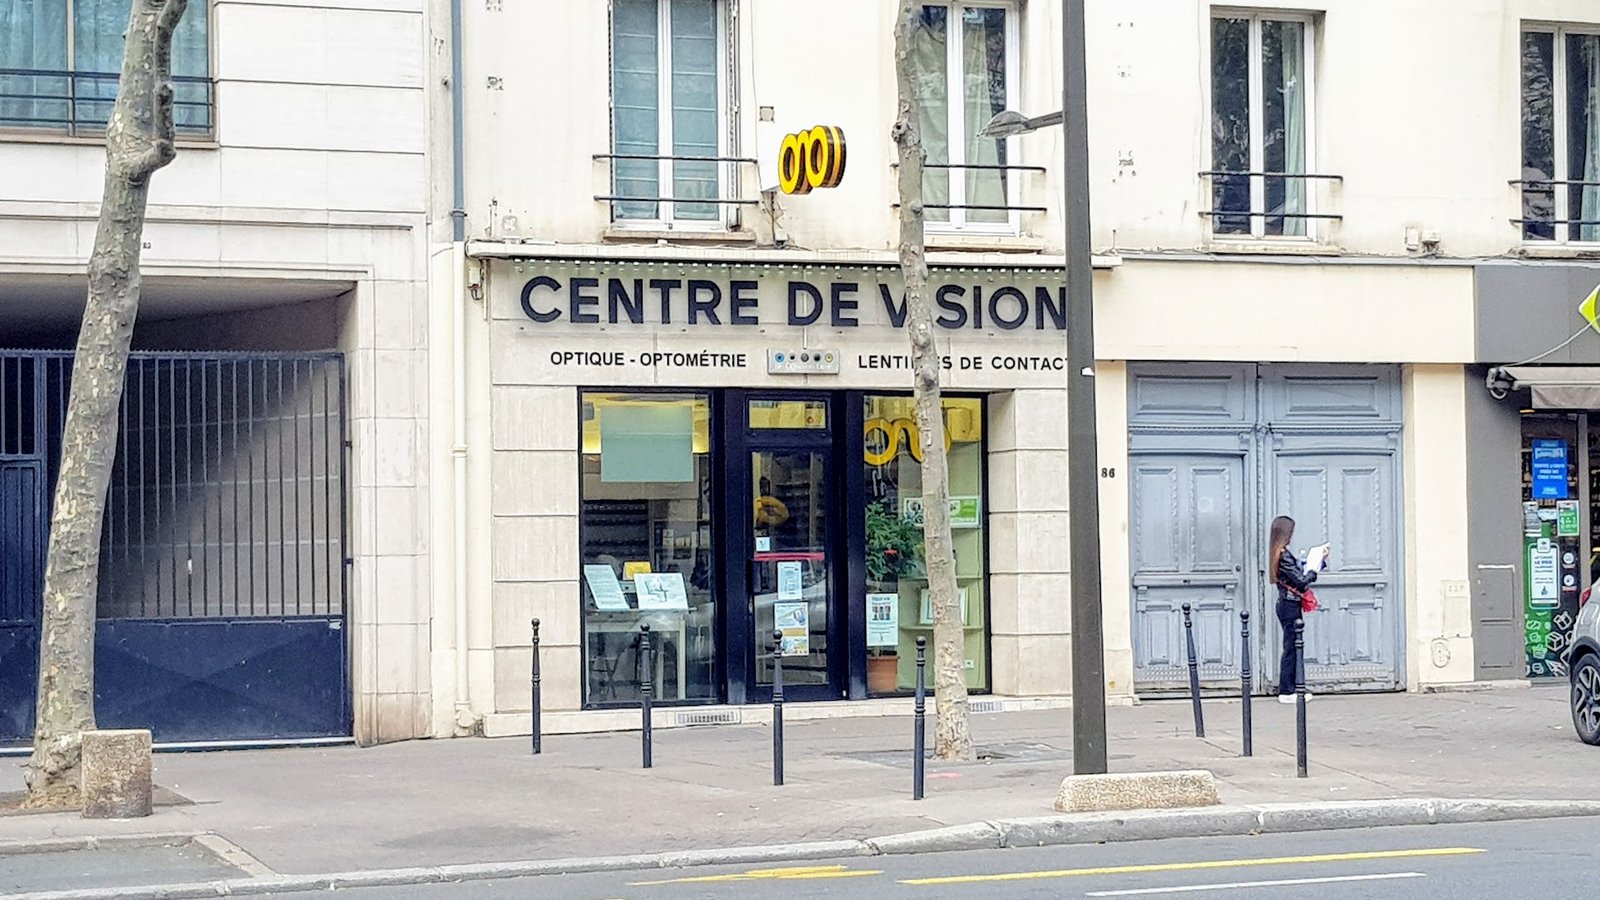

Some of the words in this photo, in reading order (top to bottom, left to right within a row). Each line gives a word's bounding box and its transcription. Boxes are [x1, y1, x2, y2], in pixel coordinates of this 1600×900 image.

[520, 275, 759, 326] CENTRE
[787, 281, 859, 328] DE
[878, 283, 1067, 330] VSION
[550, 351, 625, 367] OPTIQUE
[640, 350, 747, 368] OPTOMÉTRIE
[960, 356, 983, 370] DE
[991, 356, 1068, 371] CONTAC
[1101, 467, 1116, 478] 86
